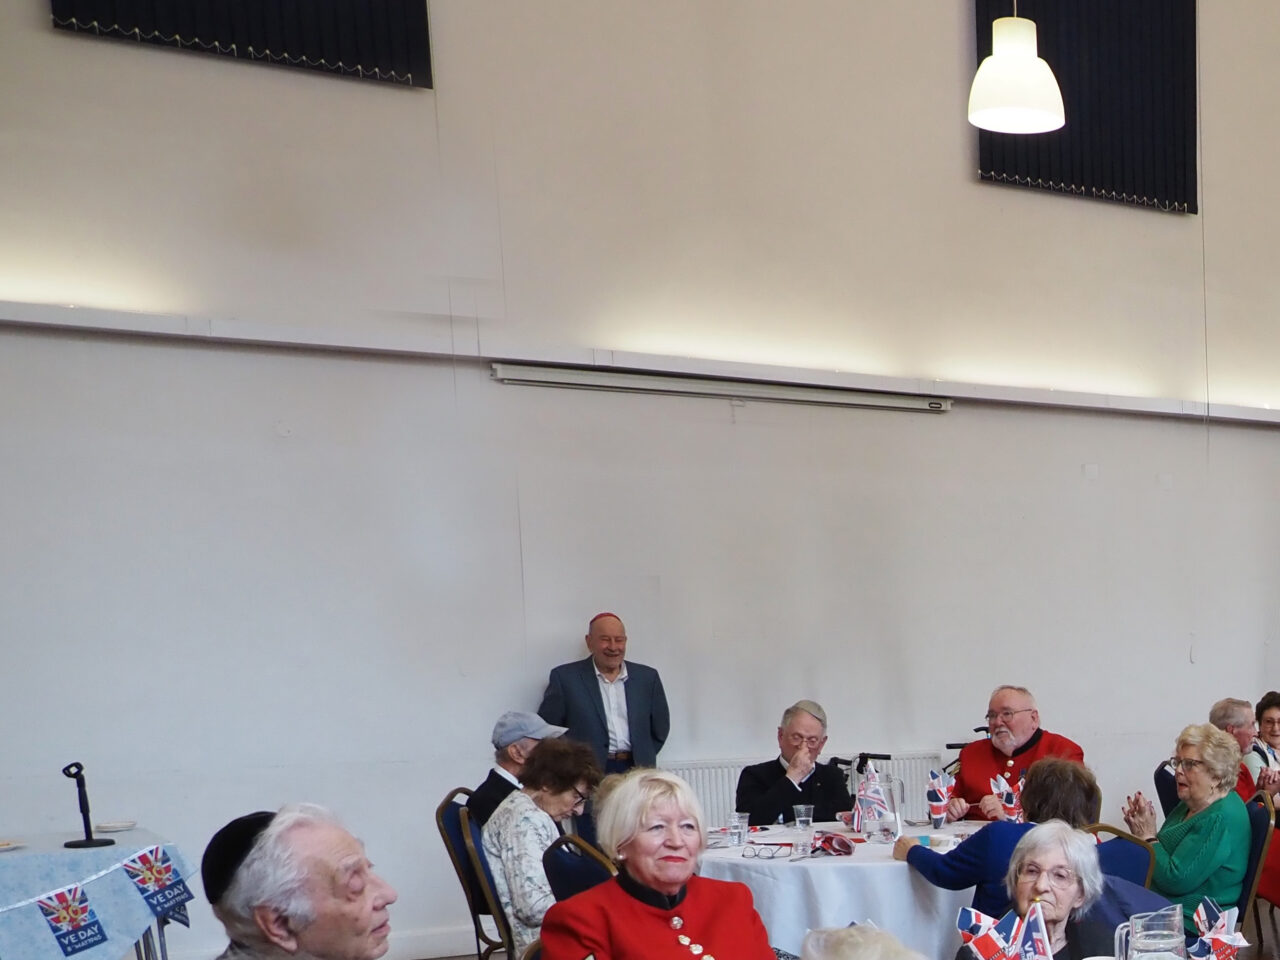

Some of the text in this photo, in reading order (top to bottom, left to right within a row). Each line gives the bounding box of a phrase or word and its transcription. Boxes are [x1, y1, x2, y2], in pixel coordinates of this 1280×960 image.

[149, 884, 185, 905] VE DAY
[60, 925, 100, 945] VE DAY
[1023, 941, 1035, 960] VE
